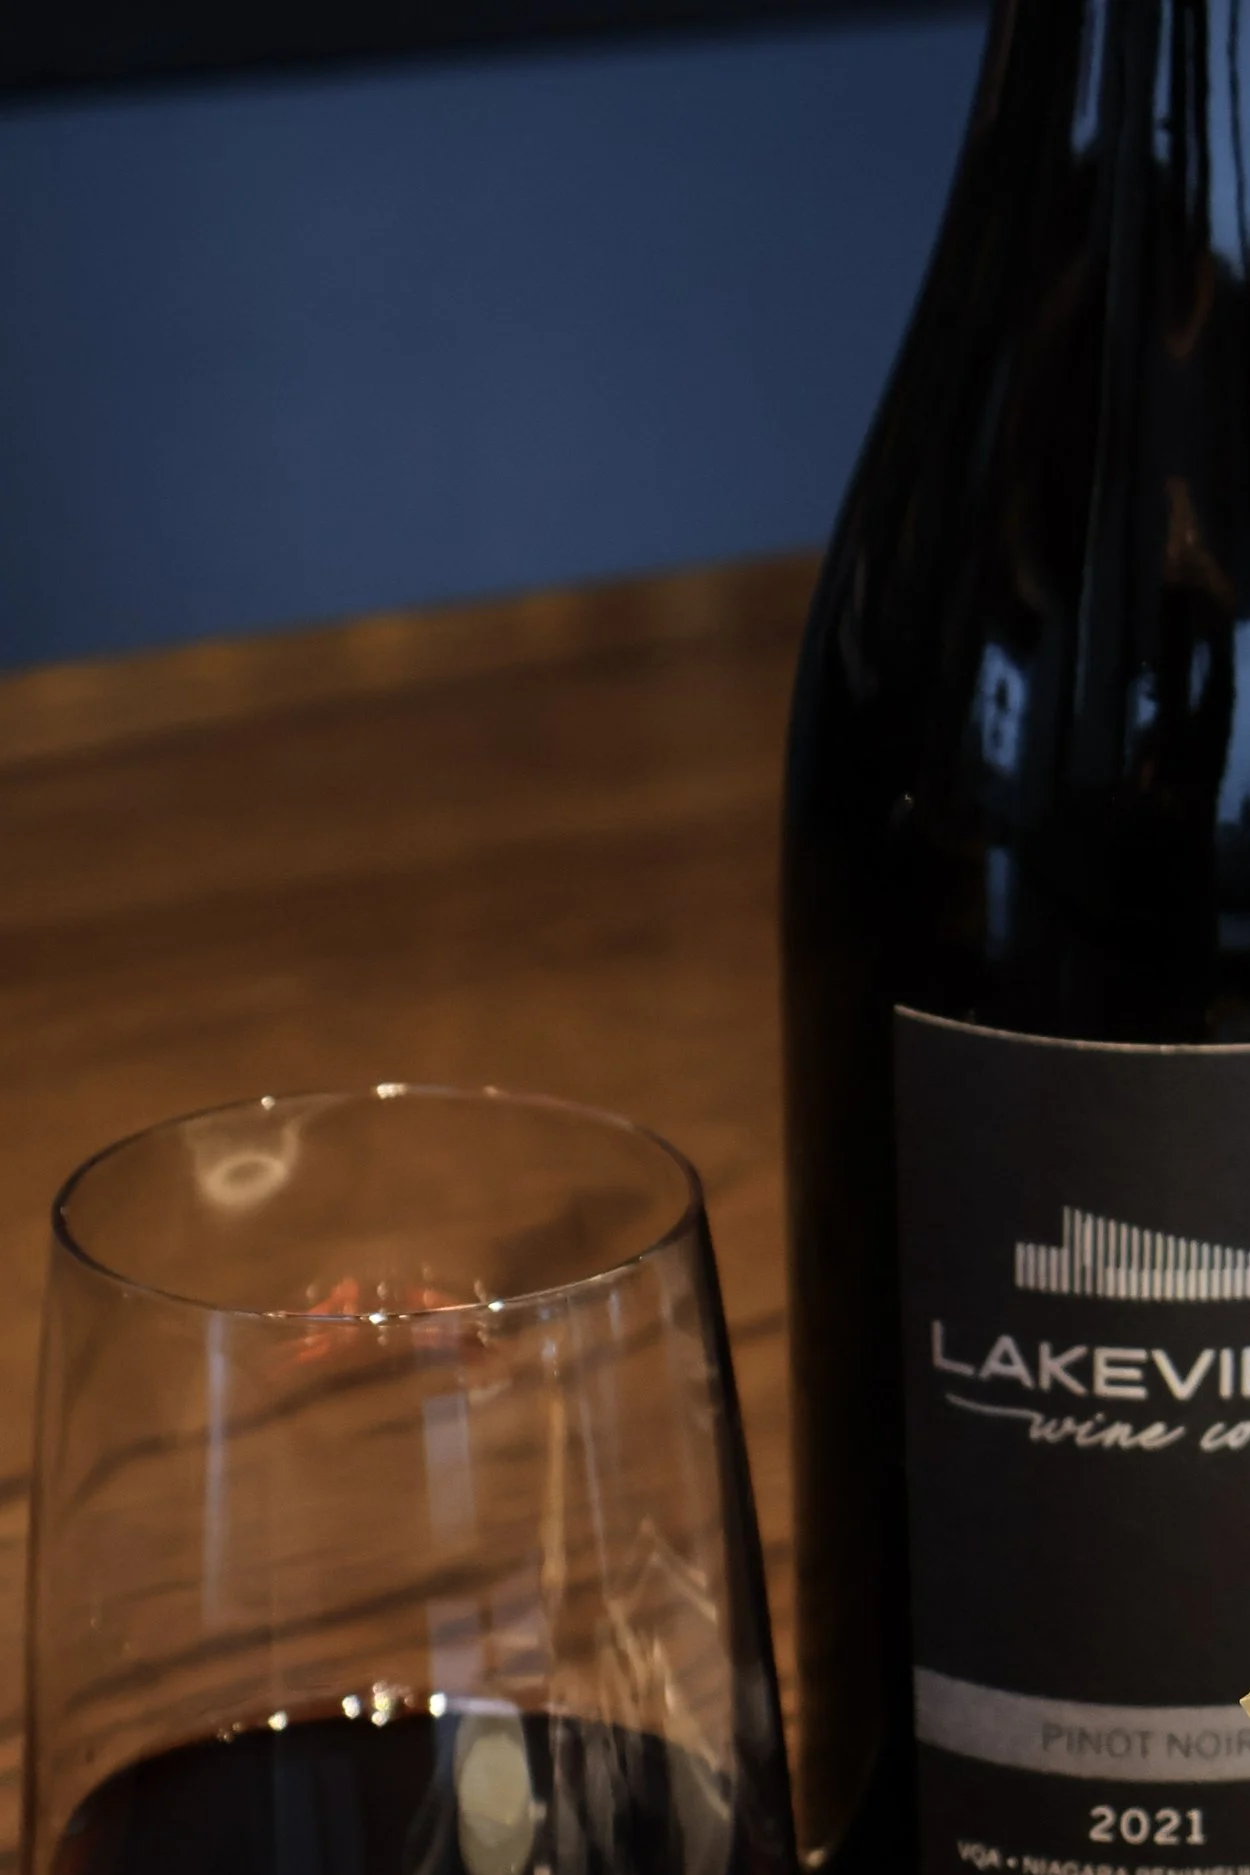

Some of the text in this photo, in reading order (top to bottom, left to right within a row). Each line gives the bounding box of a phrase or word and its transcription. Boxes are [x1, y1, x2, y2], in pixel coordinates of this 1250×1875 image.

[1040, 1721, 1151, 1759] PINOT
[1088, 1804, 1206, 1846] 2021
[956, 1839, 1001, 1870] VQA
